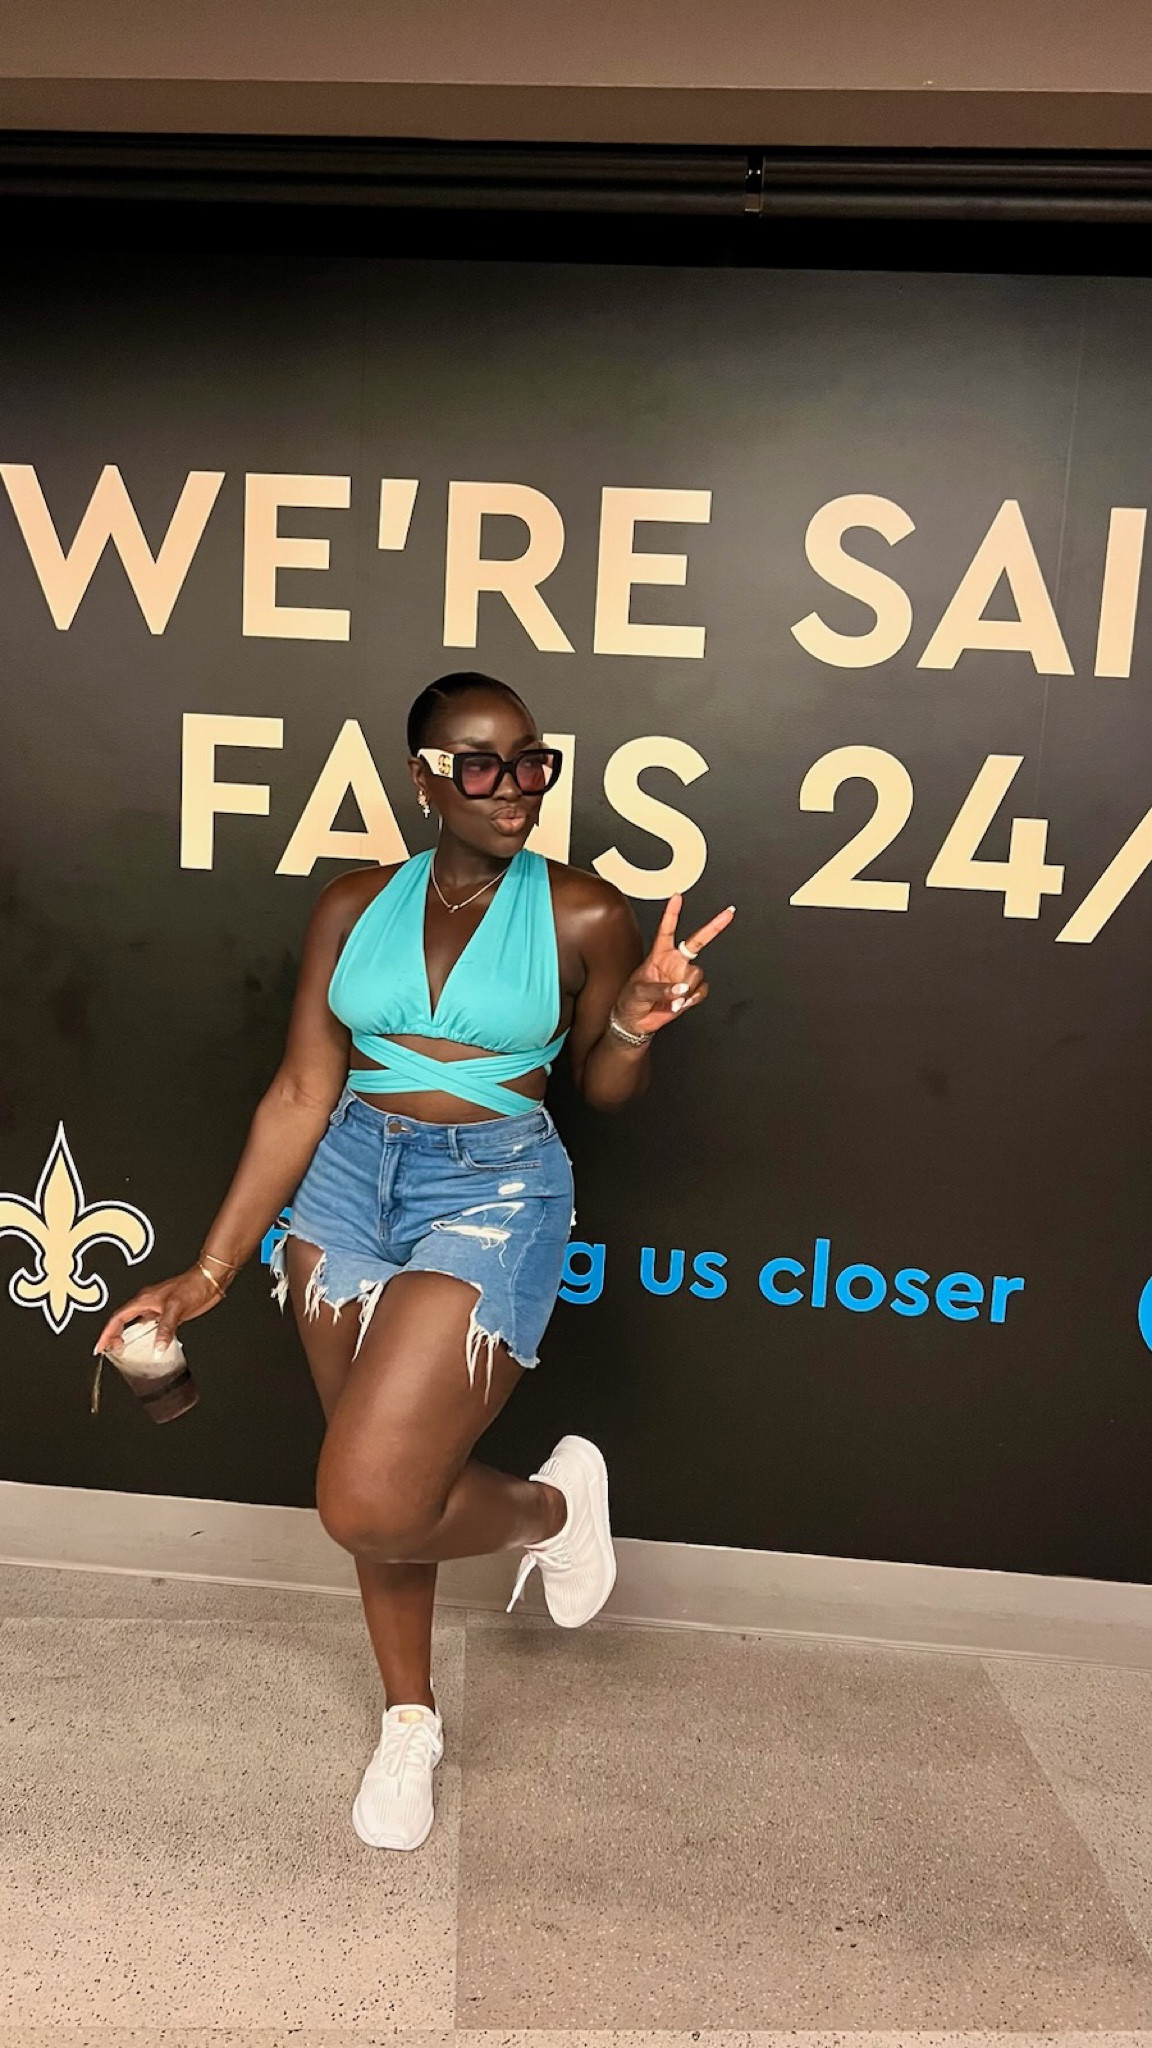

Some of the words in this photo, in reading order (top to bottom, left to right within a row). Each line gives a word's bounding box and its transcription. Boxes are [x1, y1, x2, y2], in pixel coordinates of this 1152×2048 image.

[0, 463, 712, 658] WE'RE
[640, 1246, 729, 1300] us
[758, 1238, 1025, 1323] closer
